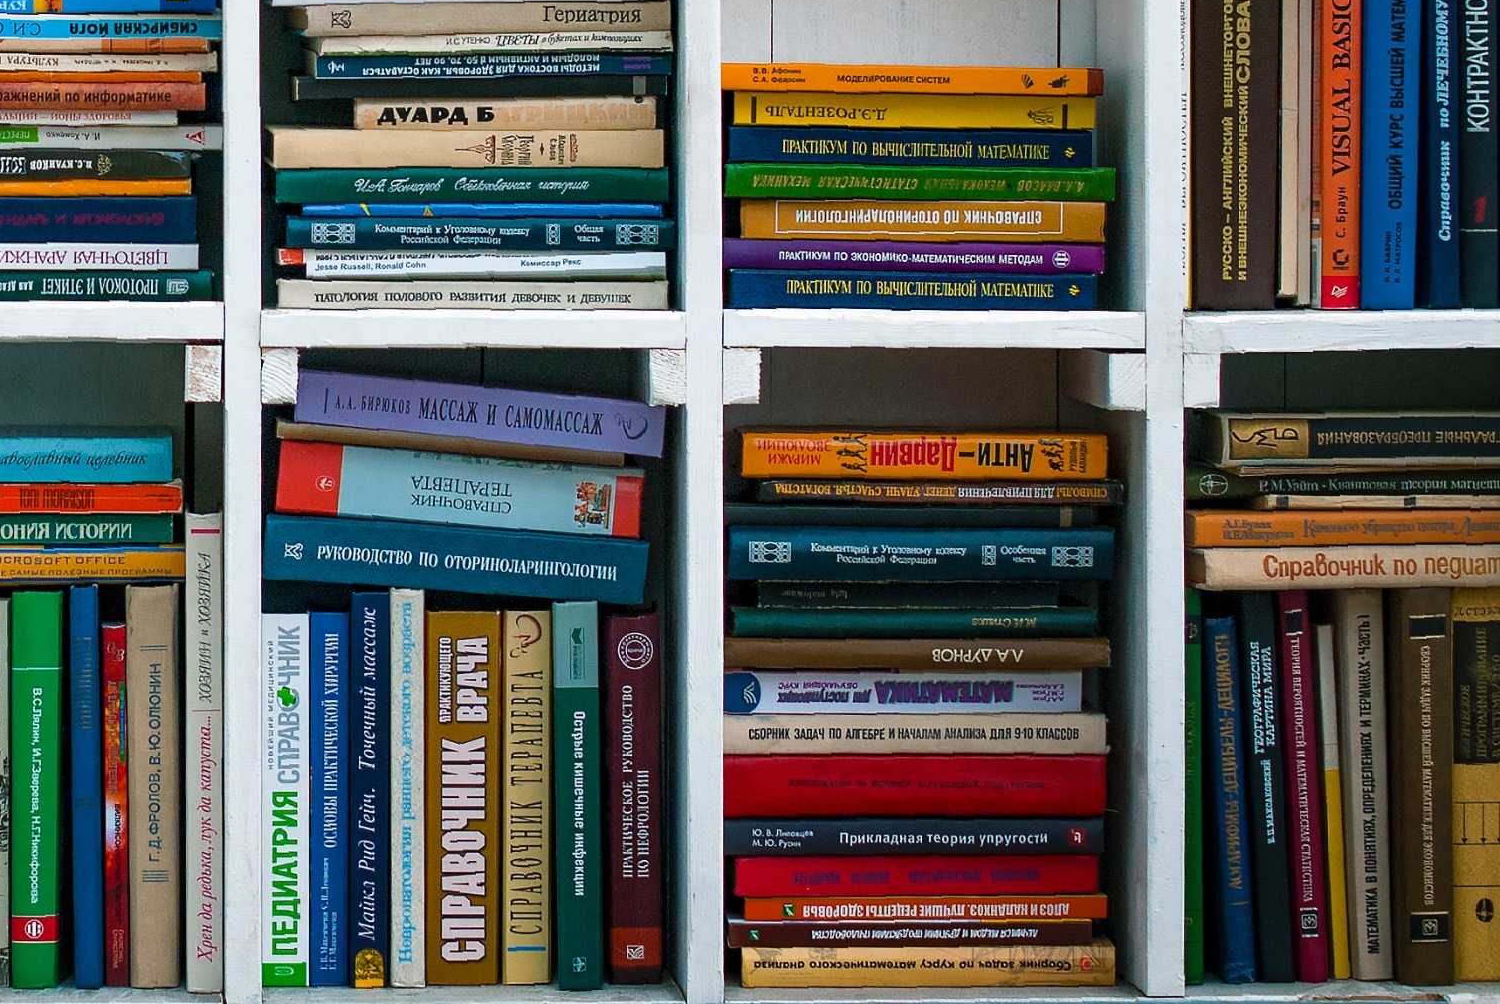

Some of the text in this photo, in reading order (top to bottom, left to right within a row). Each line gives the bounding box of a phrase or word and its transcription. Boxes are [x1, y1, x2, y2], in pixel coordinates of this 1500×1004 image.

[542, 6, 642, 25] Гериатрия
[65, 91, 79, 103] по
[84, 89, 172, 105] информатике
[1332, 78, 1354, 177] VISUAL
[782, 140, 1050, 159] ПРАКТИКУМ ПО ВЫЧИСЛИТЕЛЬНОЙ МАТЕМАТИКЕ
[796, 209, 1042, 224] СПРАВОЧНИК ПО ОТОРИНОЛАРИНГОЛОГИИ
[73, 250, 168, 265] ЦВЕТОЧНАЯ
[418, 397, 479, 424] МАССАЖ
[505, 404, 604, 435] САМОМАССАЖ
[55, 523, 133, 540] ИСТОРИИ
[317, 544, 618, 581] РУКОВОДСТВО ПО ОТОРИНОЛАРИНГОЛОГИИ
[1262, 554, 1419, 581] Справочник по
[456, 636, 489, 723] ВРАЧА
[749, 728, 790, 740] СБОРНИК
[794, 728, 824, 740] ЗАДАЧ
[829, 728, 842, 739] ПО
[898, 728, 941, 740] НАЧАЛАМ
[944, 728, 986, 740] АНАЛИЗА
[1036, 728, 1079, 740] КЛАССОВ
[198, 797, 212, 812] да
[510, 670, 543, 935] СПРАВОЧНИК ТЕРАПЕВТА
[200, 817, 217, 844] лук
[839, 830, 1048, 847] Прикладная теория упругости
[440, 736, 487, 962] СПРАВОЧНИК
[271, 790, 301, 957] ПЕДИАТРИЯ
[197, 904, 212, 920] да
[197, 924, 217, 962] Хрен
